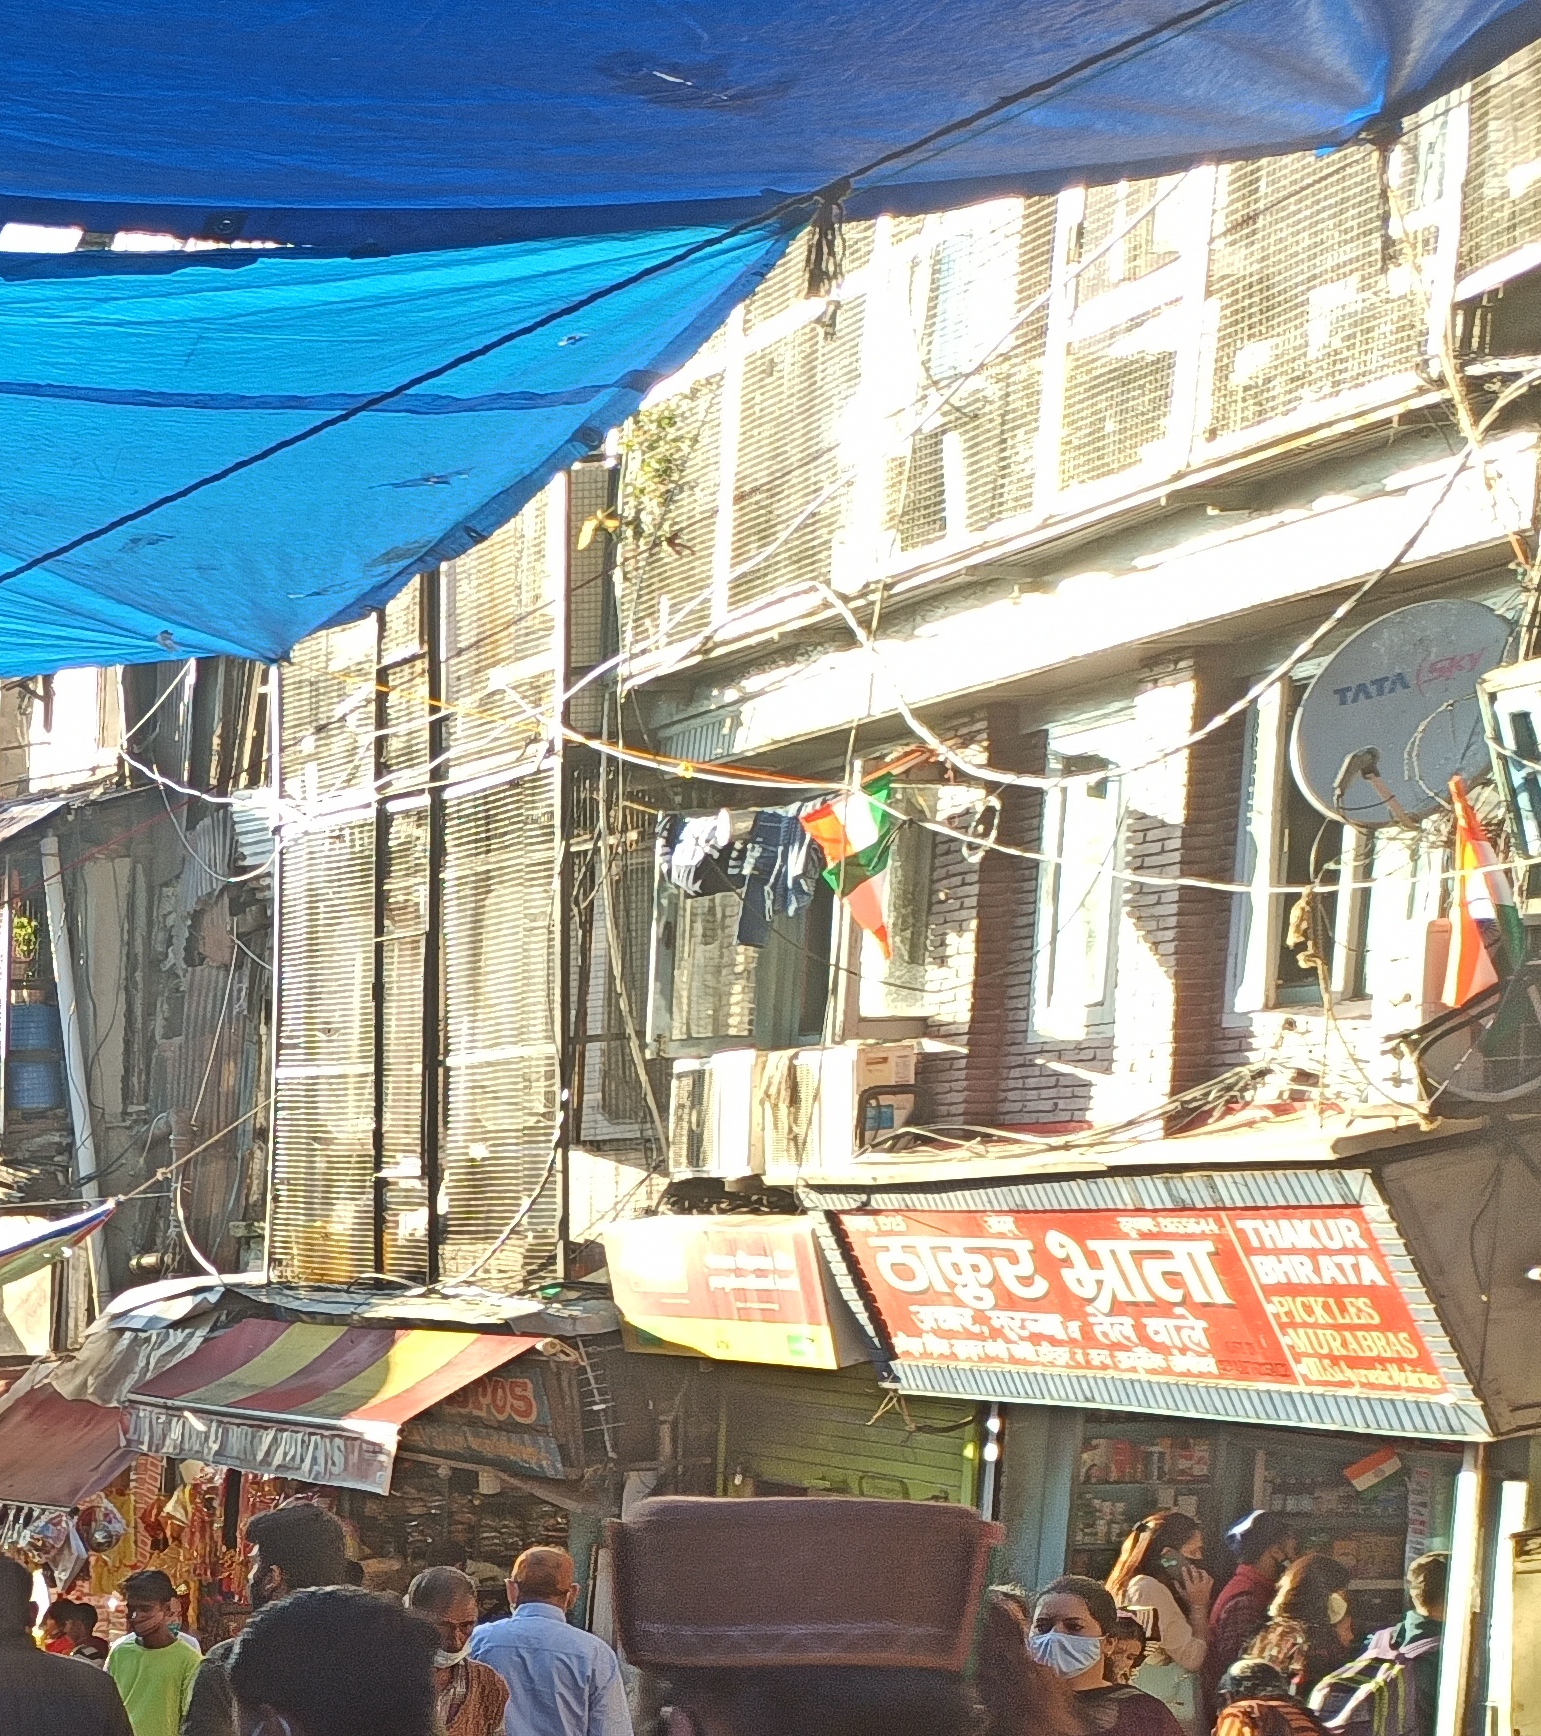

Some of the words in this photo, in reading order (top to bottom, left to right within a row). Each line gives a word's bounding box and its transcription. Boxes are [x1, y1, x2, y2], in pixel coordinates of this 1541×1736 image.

[1333, 672, 1411, 706] TATA
[1236, 1218, 1369, 1249] THAKUR
[868, 1235, 1049, 1310] ठाकुर
[1044, 1228, 1235, 1313] भ्राता
[1250, 1255, 1390, 1286] BHRATA
[1272, 1296, 1380, 1324] PICKLES
[1085, 1306, 1141, 1346] तेल
[1140, 1306, 1211, 1353] वाले
[1286, 1328, 1419, 1358] MURABBAS
